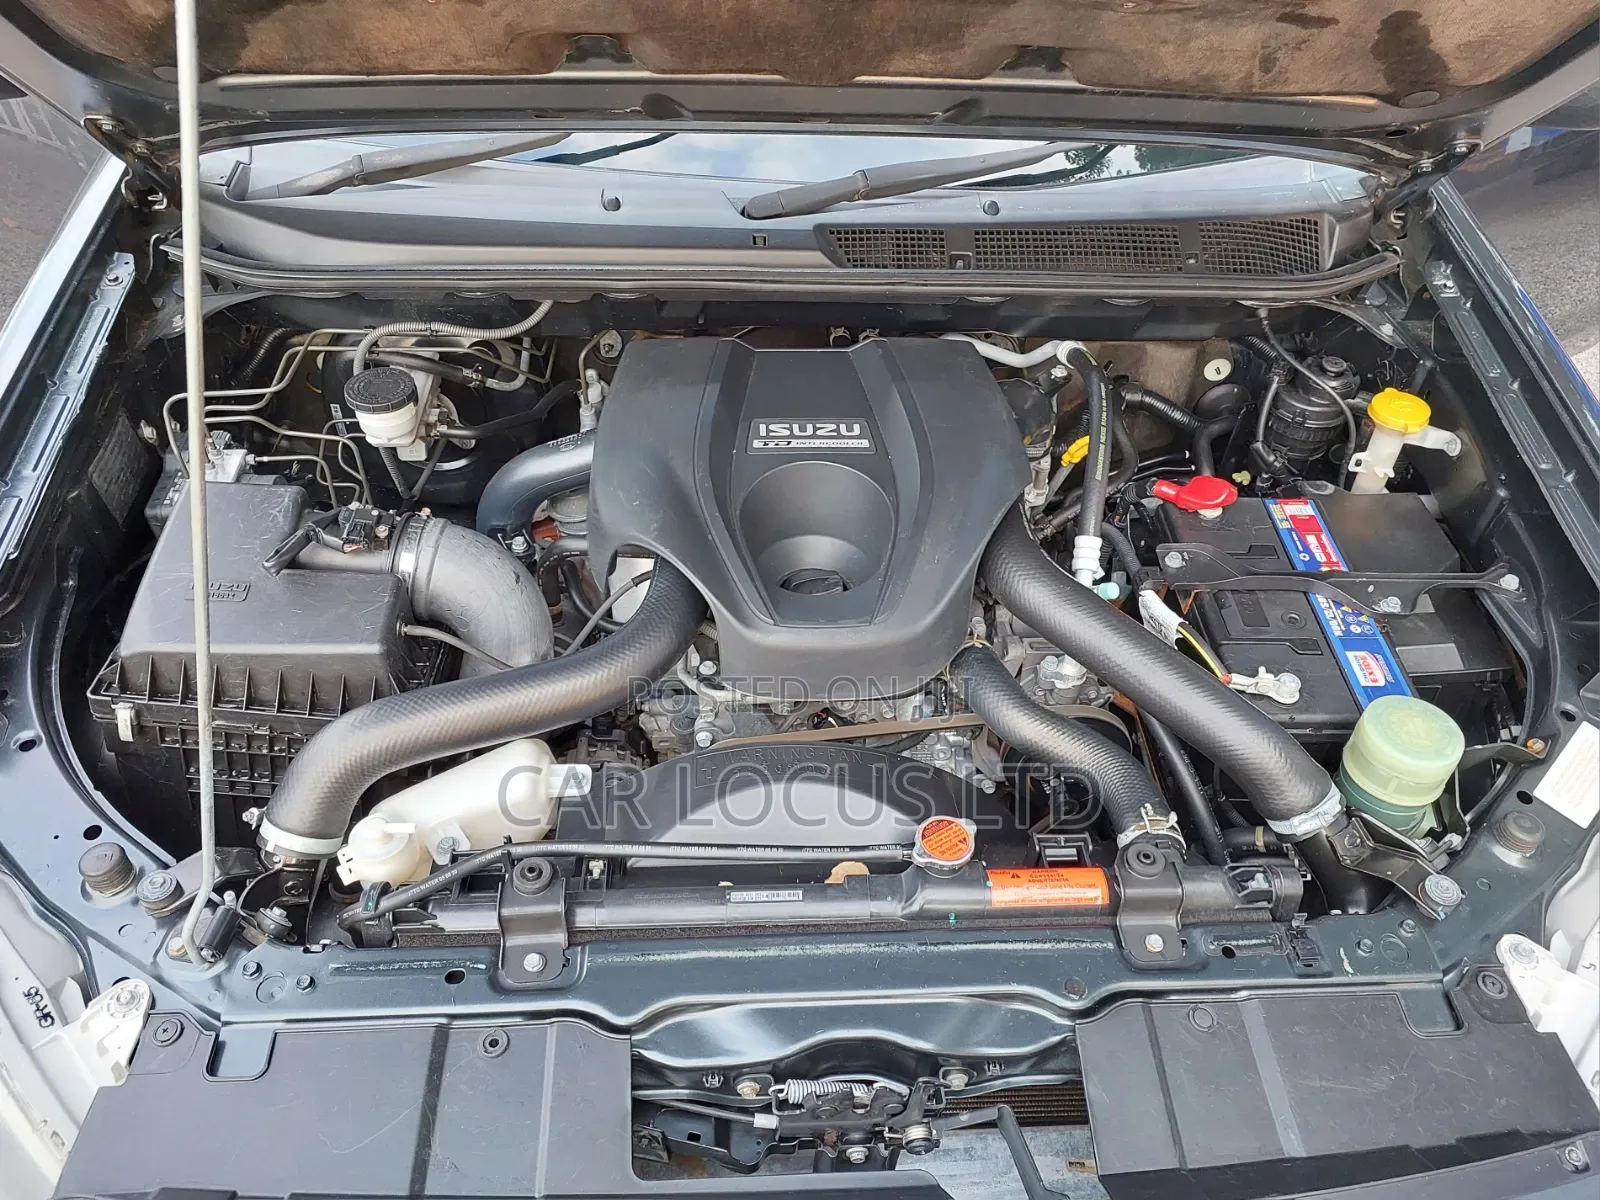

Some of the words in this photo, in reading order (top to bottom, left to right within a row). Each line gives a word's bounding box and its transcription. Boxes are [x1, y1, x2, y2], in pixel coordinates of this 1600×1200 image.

[759, 423, 861, 437] ISUZU
[1360, 655, 1379, 683] EXIDE
[485, 850, 501, 859] WATE
[420, 878, 440, 892] WATER
